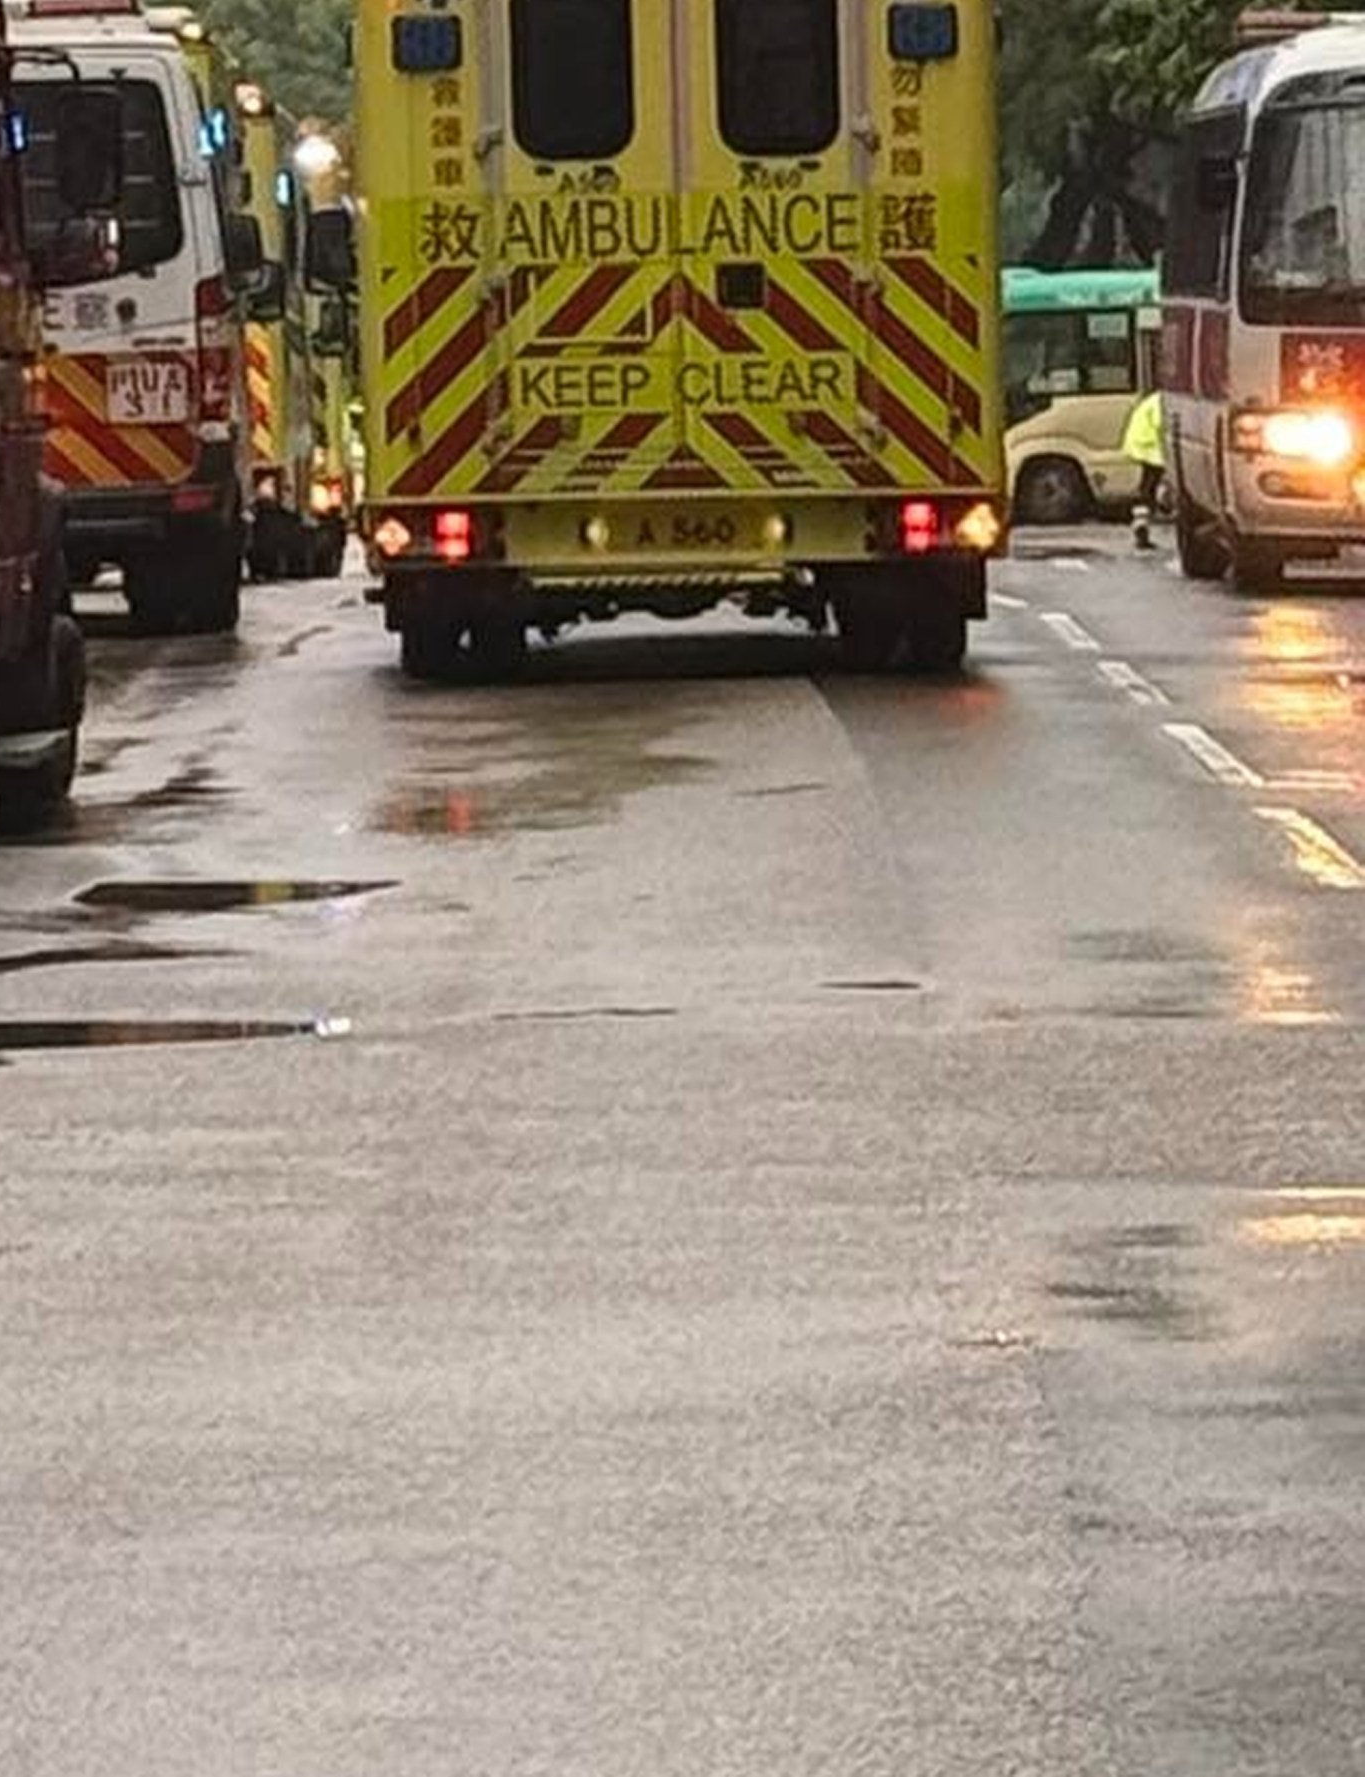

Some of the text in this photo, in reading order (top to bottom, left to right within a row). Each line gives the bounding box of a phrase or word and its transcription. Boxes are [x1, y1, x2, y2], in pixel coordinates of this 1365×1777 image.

[421, 191, 937, 263] 救 AMBULANCE 護
[519, 357, 844, 408] KEEP CLEAR
